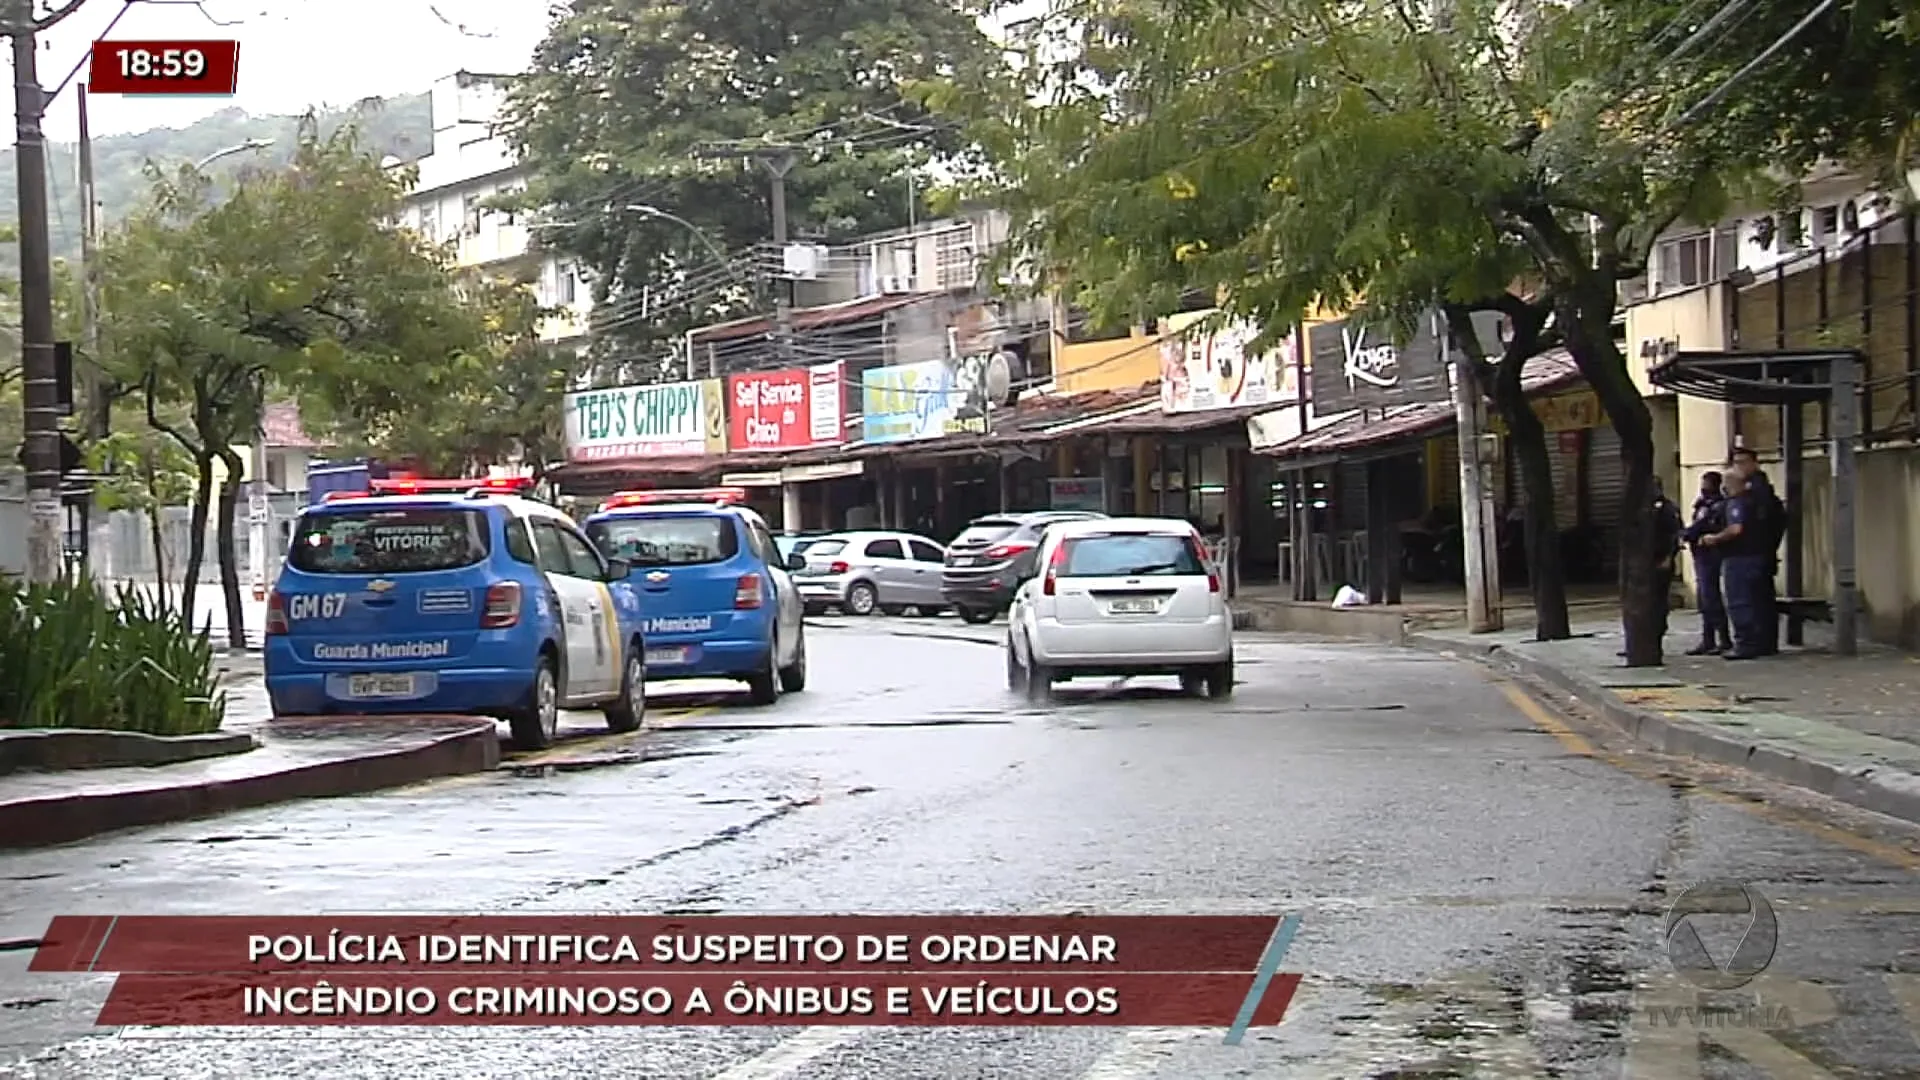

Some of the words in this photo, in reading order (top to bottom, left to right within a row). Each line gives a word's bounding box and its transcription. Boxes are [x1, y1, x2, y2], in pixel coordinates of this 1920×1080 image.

[736, 380, 760, 408] Self
[760, 379, 804, 407] Service
[576, 391, 628, 440] TED'S
[633, 384, 700, 436] CHIPPY
[746, 417, 781, 443] Chico
[291, 594, 319, 620] GM
[322, 592, 347, 618] 67
[651, 615, 711, 633] Municipal
[314, 642, 369, 659] Guarda
[372, 639, 448, 660] Municipal
